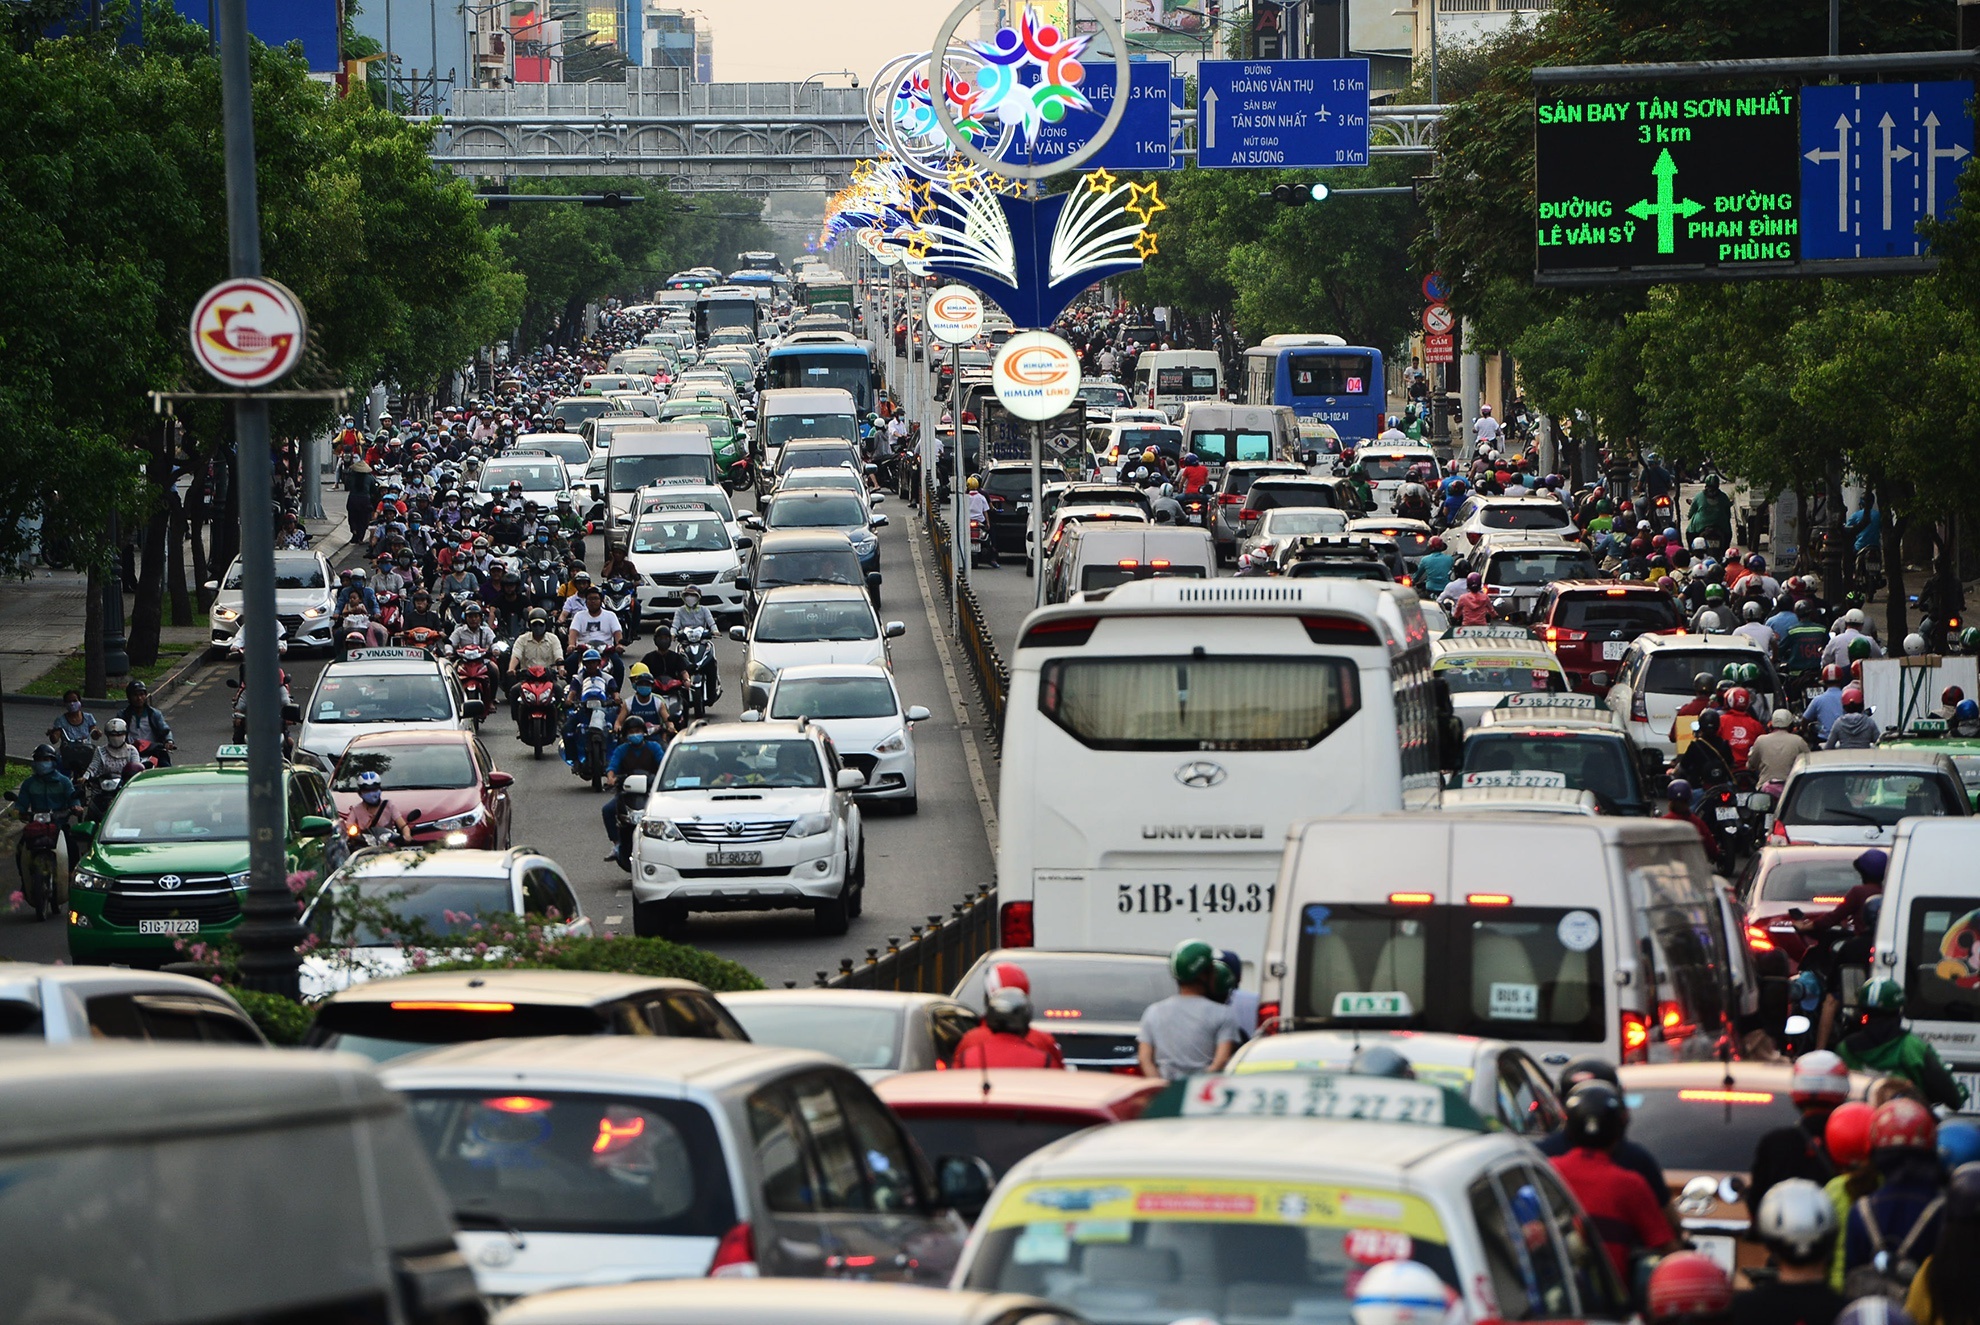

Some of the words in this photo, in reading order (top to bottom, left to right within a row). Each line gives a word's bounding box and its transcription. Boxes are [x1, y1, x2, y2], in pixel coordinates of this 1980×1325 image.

[1244, 64, 1272, 75] ĐƯỜNG
[1231, 78, 1267, 93] HOÀNG
[1270, 77, 1291, 92] VĂN
[1294, 79, 1314, 95] THỤ
[1348, 79, 1364, 91] Km
[1145, 86, 1166, 98] Km
[1243, 99, 1260, 110] SÂN
[1262, 101, 1277, 110] BAY
[1539, 100, 1582, 124] SÂN
[1587, 102, 1630, 122] BAY
[1637, 96, 1678, 120] TÂN
[1684, 97, 1731, 118] SƠN
[1736, 89, 1792, 116] NHẤT
[1232, 113, 1252, 128] TÂN
[1255, 115, 1276, 128] SƠN
[1279, 110, 1307, 128] NHẤT
[1339, 115, 1345, 127] 3
[1347, 114, 1364, 126] Km
[1039, 126, 1067, 137] ƯỜNG
[1638, 125, 1651, 143] 3
[1656, 124, 1691, 143] km
[1036, 140, 1064, 155] VĂN
[1136, 142, 1141, 153] 1
[1144, 141, 1166, 153] Km
[1243, 136, 1259, 146] NÚT
[1261, 137, 1279, 146] GIAO
[1231, 152, 1246, 163] AN
[1249, 151, 1284, 163] SƯƠNG
[1335, 151, 1345, 162] 10
[1347, 150, 1364, 162] Km
[1539, 196, 1613, 219] ĐƯỜNG
[1714, 190, 1793, 213] ĐƯỜNG
[1688, 221, 1743, 239] PHAN
[1748, 214, 1798, 236] ĐÌNH
[1538, 224, 1563, 246] LÊ
[1566, 222, 1606, 245] VĂN
[1609, 221, 1636, 243] SỸ
[1719, 239, 1791, 261] PHÙNG
[1431, 337, 1448, 345] CẤM
[1347, 378, 1361, 391] 04
[1004, 389, 1043, 397] HIMLAM
[1046, 389, 1071, 397] LAND
[406, 650, 423, 658] TAXI
[1507, 776, 1521, 786] 27
[1526, 776, 1540, 786] 27
[1544, 777, 1559, 787] 27
[1142, 825, 1264, 839] UNIVERSE
[1118, 883, 1276, 913] 51B-149.31
